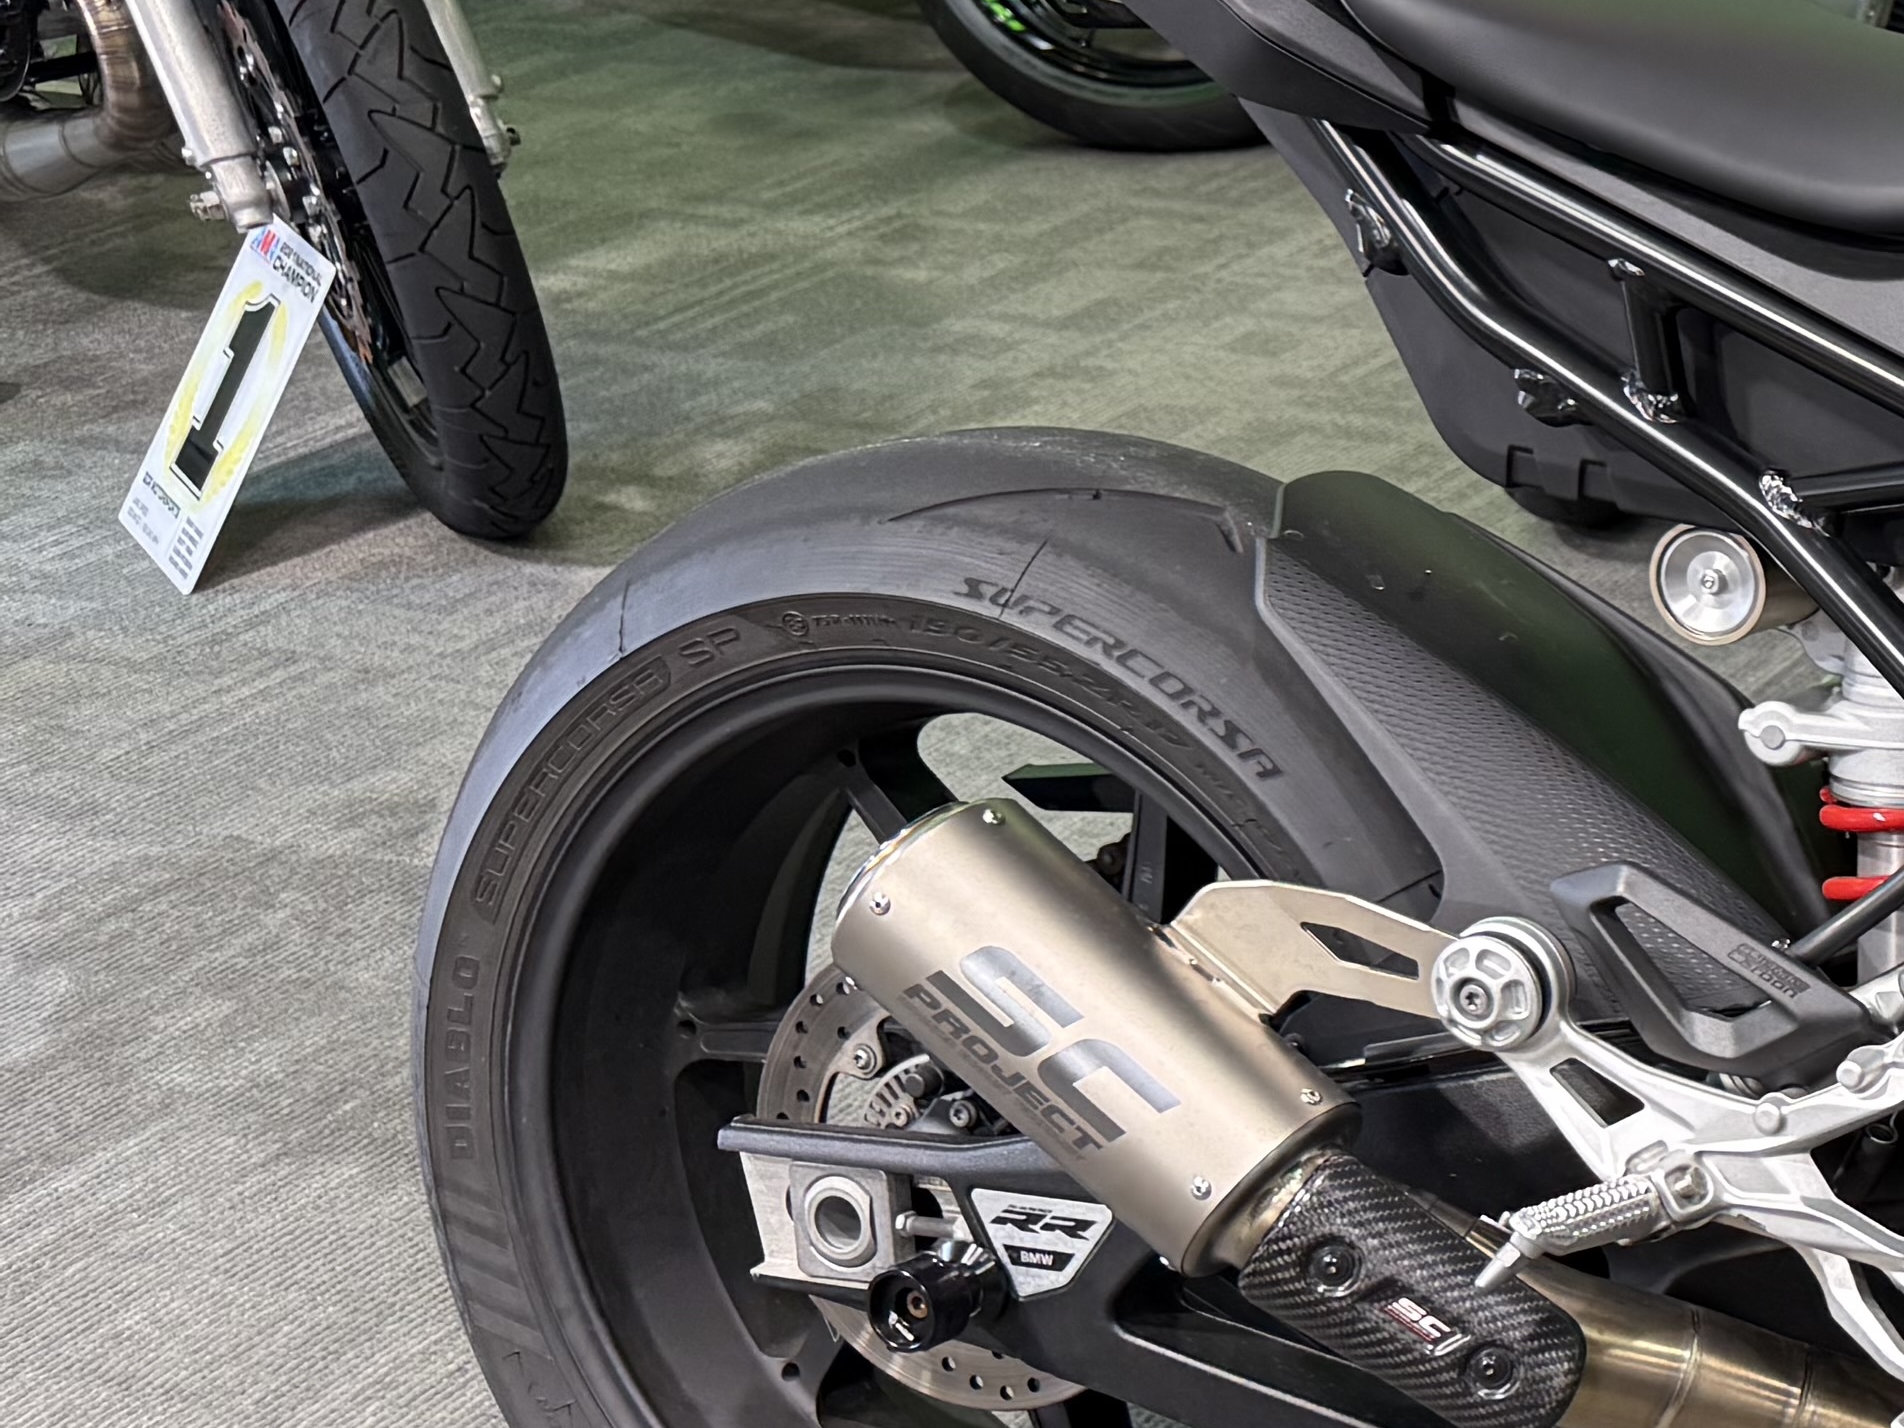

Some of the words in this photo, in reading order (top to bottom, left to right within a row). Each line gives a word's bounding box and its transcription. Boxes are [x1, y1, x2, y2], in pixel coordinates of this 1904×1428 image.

[169, 293, 281, 501] 1
[953, 576, 1284, 782] SUPERCORSA
[442, 953, 481, 1162] DIABLO
[474, 662, 666, 922] SUPERCORSA
[677, 625, 742, 668] SP
[901, 983, 1105, 1151] PROJECT
[926, 945, 1182, 1144] SC
[988, 1209, 1099, 1242] RR
[1019, 1250, 1054, 1266] BMW
